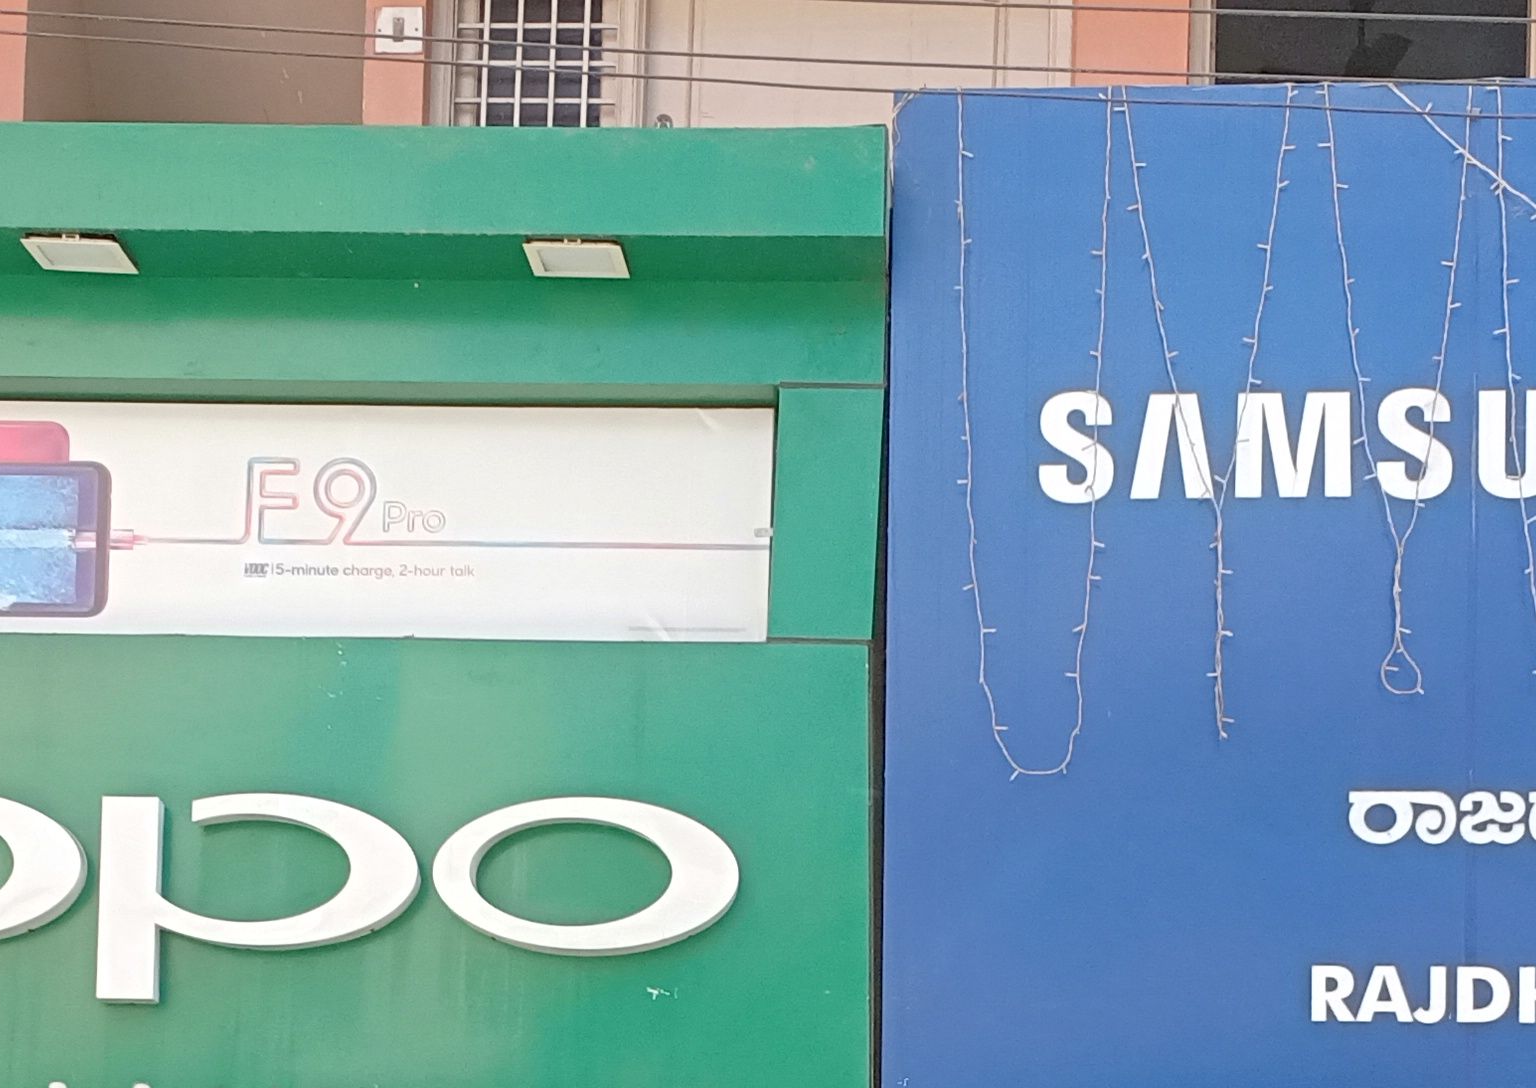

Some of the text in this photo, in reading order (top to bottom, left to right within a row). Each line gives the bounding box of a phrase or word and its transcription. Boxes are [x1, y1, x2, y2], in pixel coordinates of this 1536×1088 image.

[242, 457, 446, 543] F9 Pro
[275, 563, 476, 580] 5-minute charge, 2-hour talk
